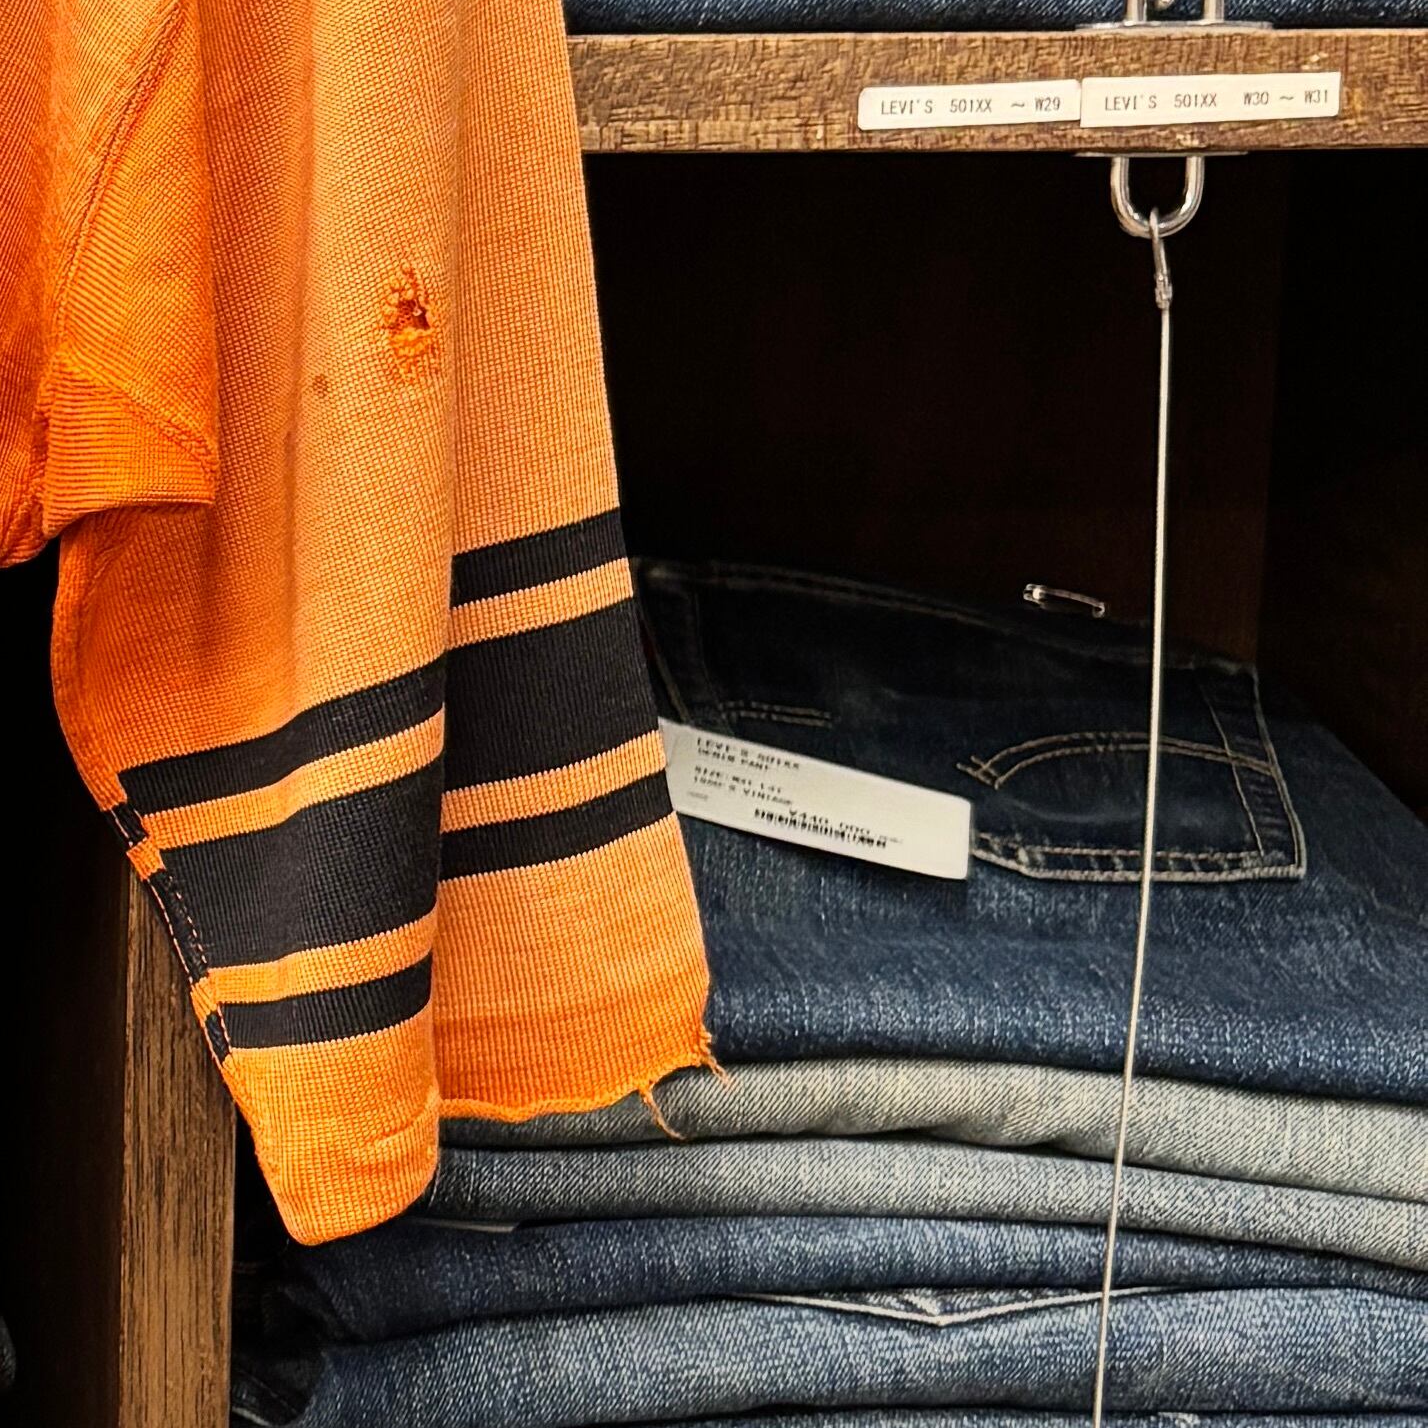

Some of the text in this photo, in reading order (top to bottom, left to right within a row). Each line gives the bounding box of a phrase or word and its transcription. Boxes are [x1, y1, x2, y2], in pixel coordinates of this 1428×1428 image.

[880, 98, 934, 117] LEVI'S
[948, 97, 993, 115] 501XX
[1034, 95, 1062, 113] W29
[1104, 94, 1158, 113] LEVI'S
[1173, 91, 1218, 109] 501XX
[1243, 89, 1270, 107] W30
[1304, 87, 1329, 105] W31
